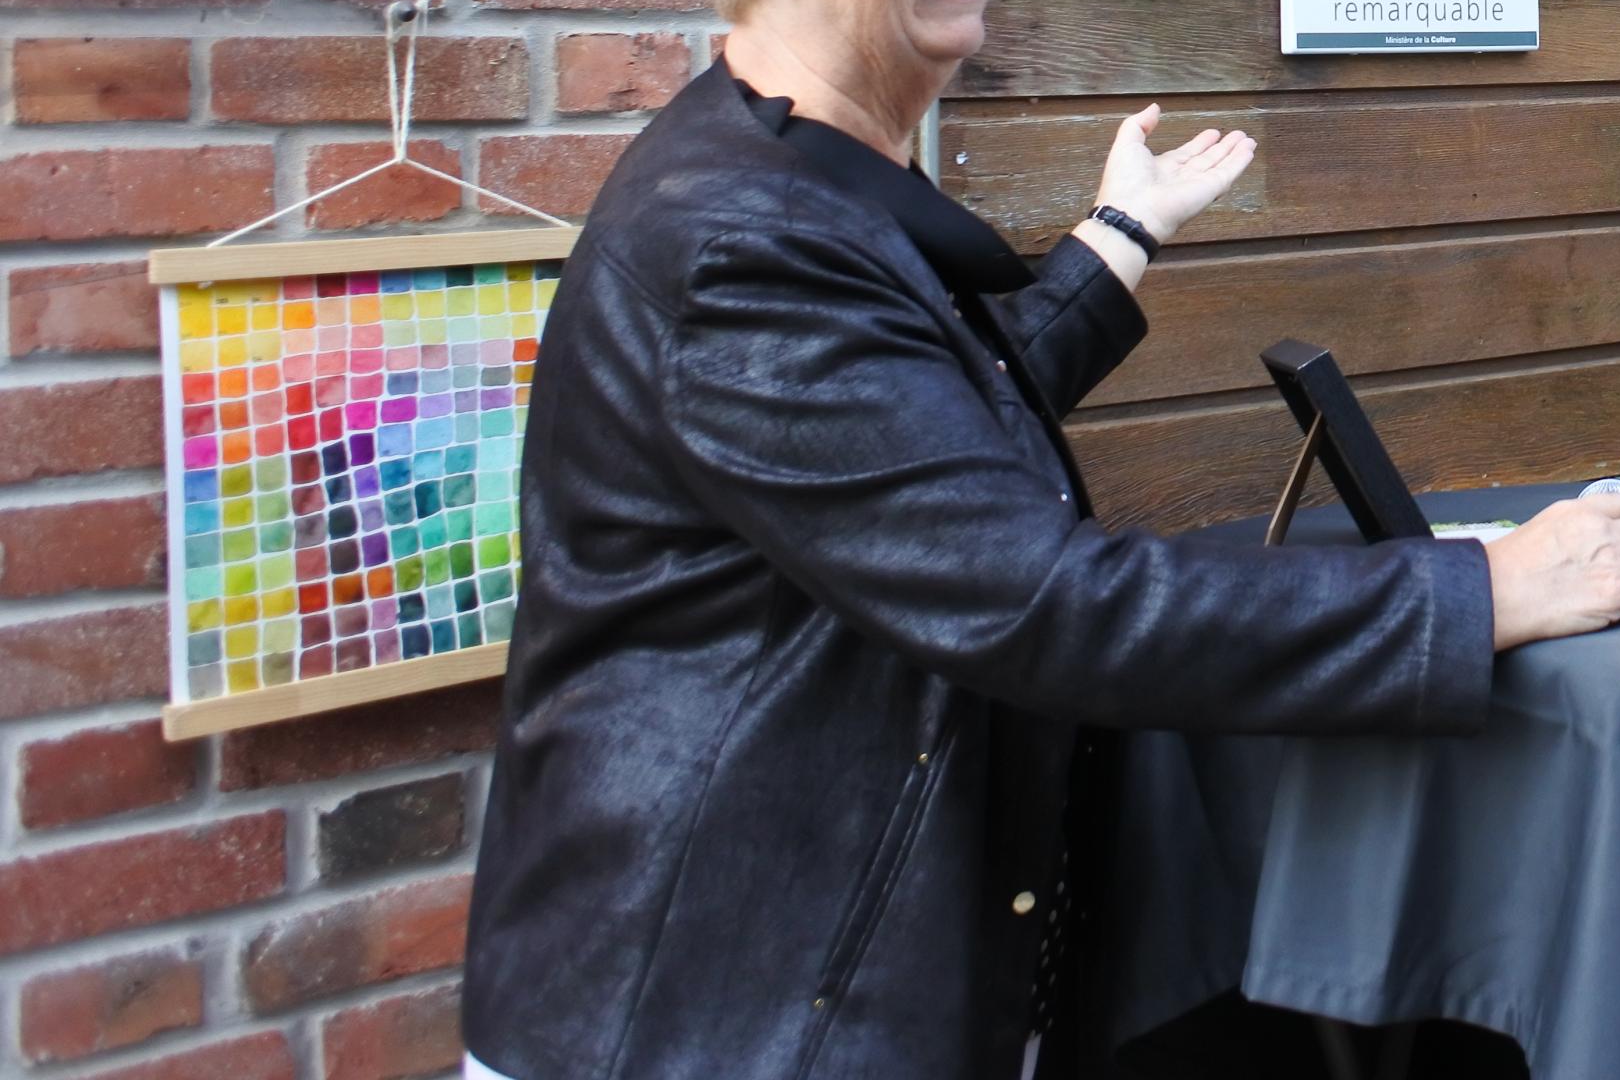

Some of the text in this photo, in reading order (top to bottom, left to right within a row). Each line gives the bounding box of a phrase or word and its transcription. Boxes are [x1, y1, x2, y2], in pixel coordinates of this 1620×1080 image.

[1385, 36, 1456, 44] Ministère de la Culture
